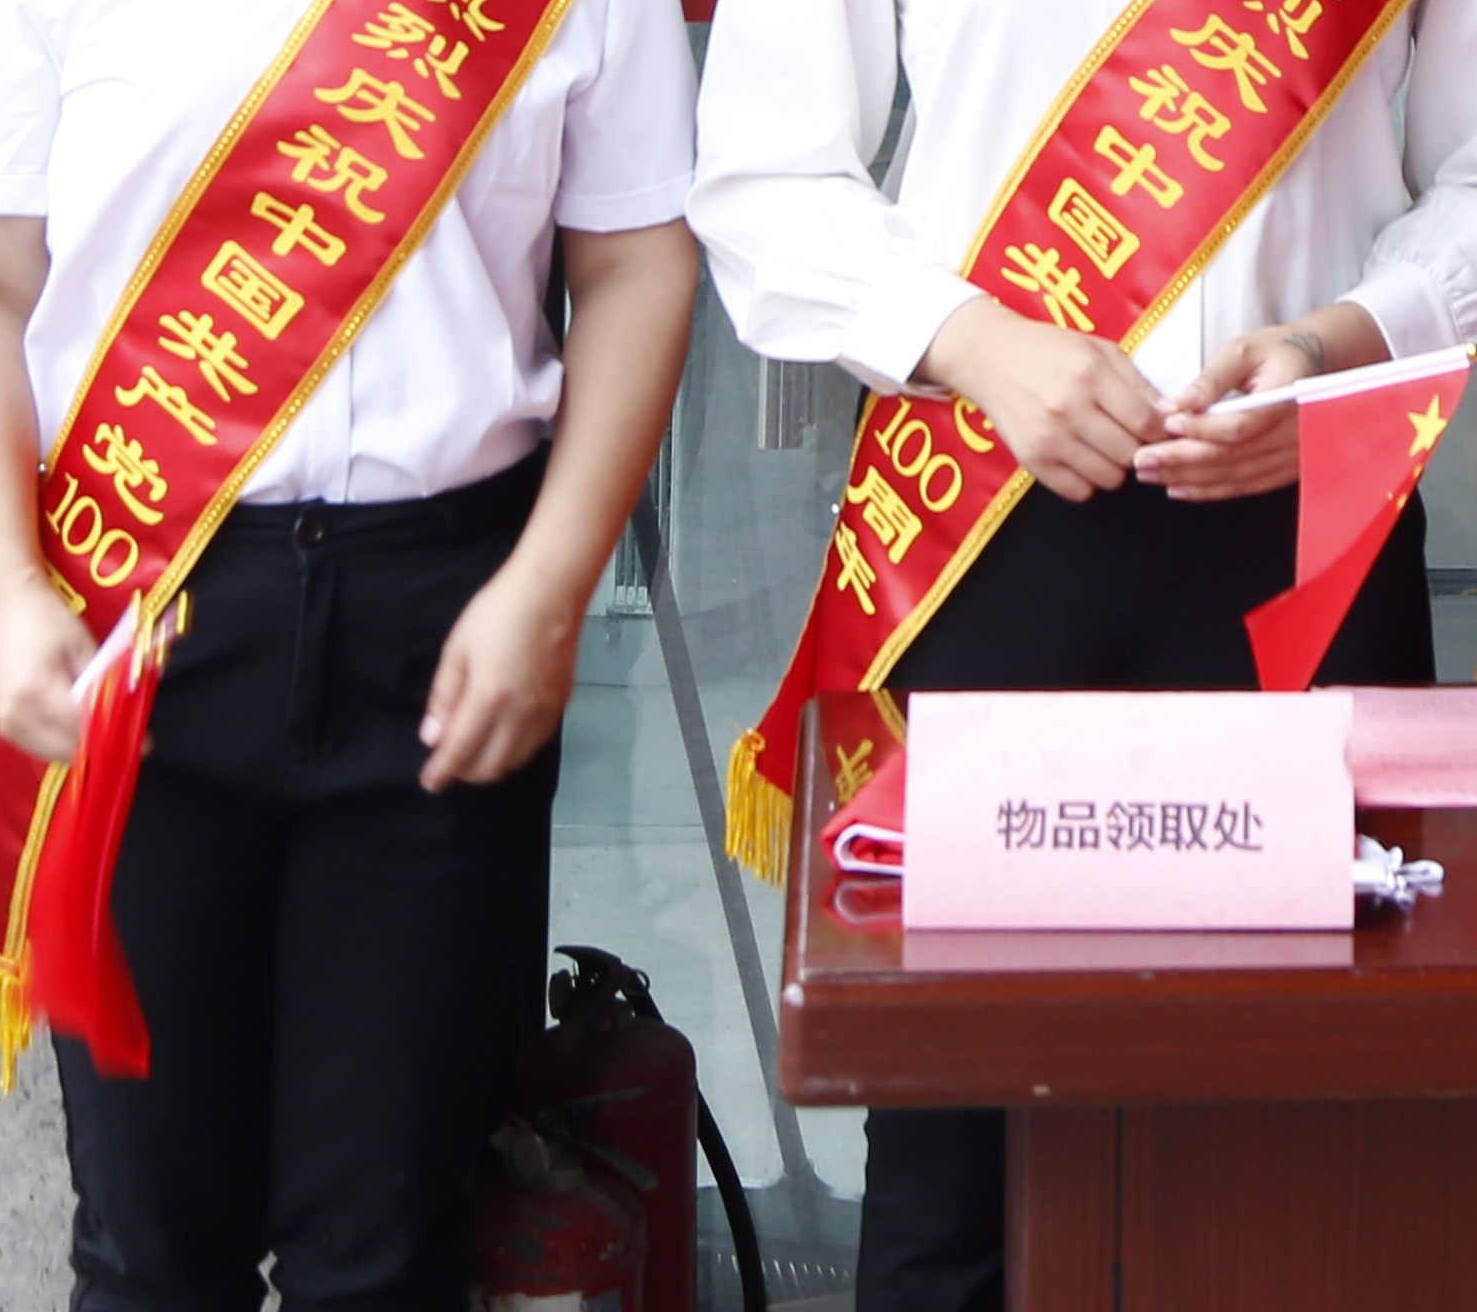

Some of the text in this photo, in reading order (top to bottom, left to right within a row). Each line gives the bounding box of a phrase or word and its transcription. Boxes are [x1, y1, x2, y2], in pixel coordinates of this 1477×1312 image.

[996, 798, 1265, 854] 物品领取处
